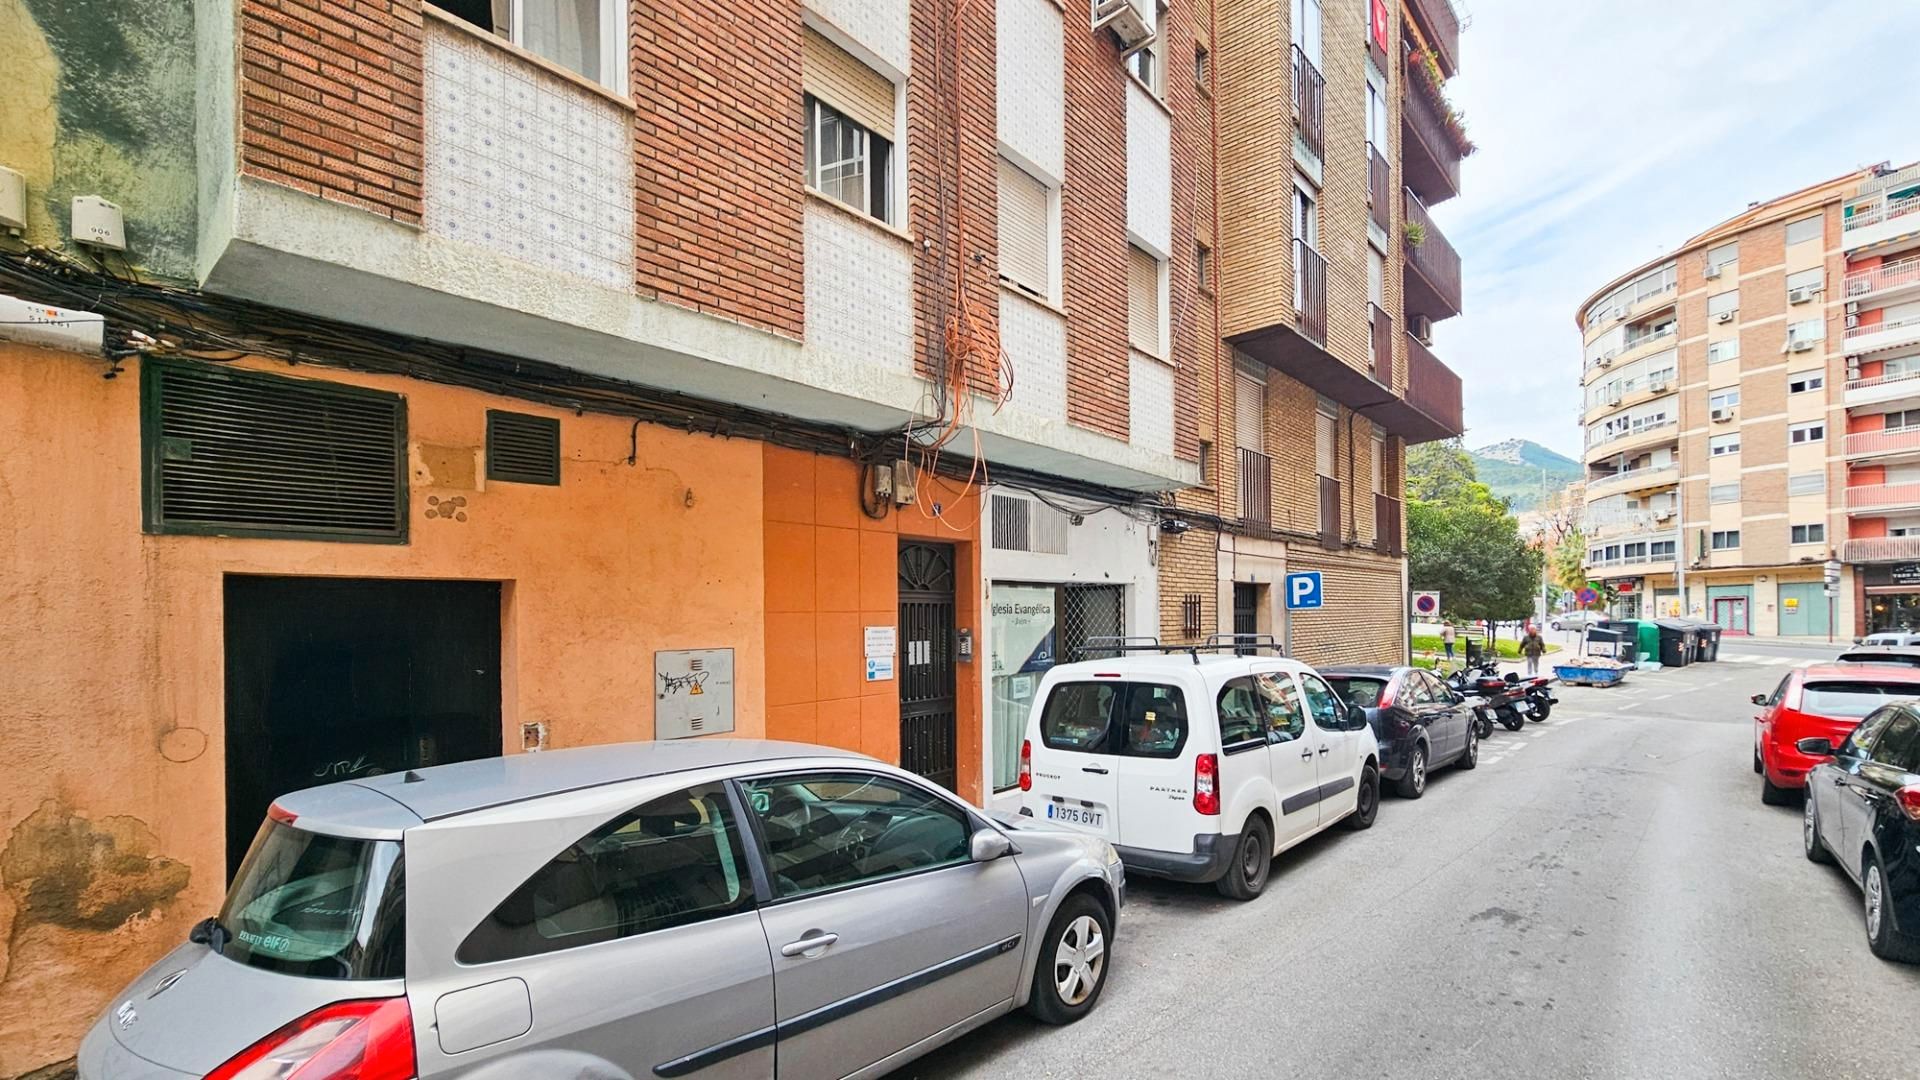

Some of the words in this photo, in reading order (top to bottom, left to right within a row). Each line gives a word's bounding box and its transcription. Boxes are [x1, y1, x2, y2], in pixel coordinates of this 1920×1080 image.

[1293, 577, 1314, 605] P
[1015, 602, 1051, 617] Evangélica
[1055, 806, 1079, 822] 1375
[1081, 811, 1102, 826] GVT
[263, 935, 281, 951] elf
